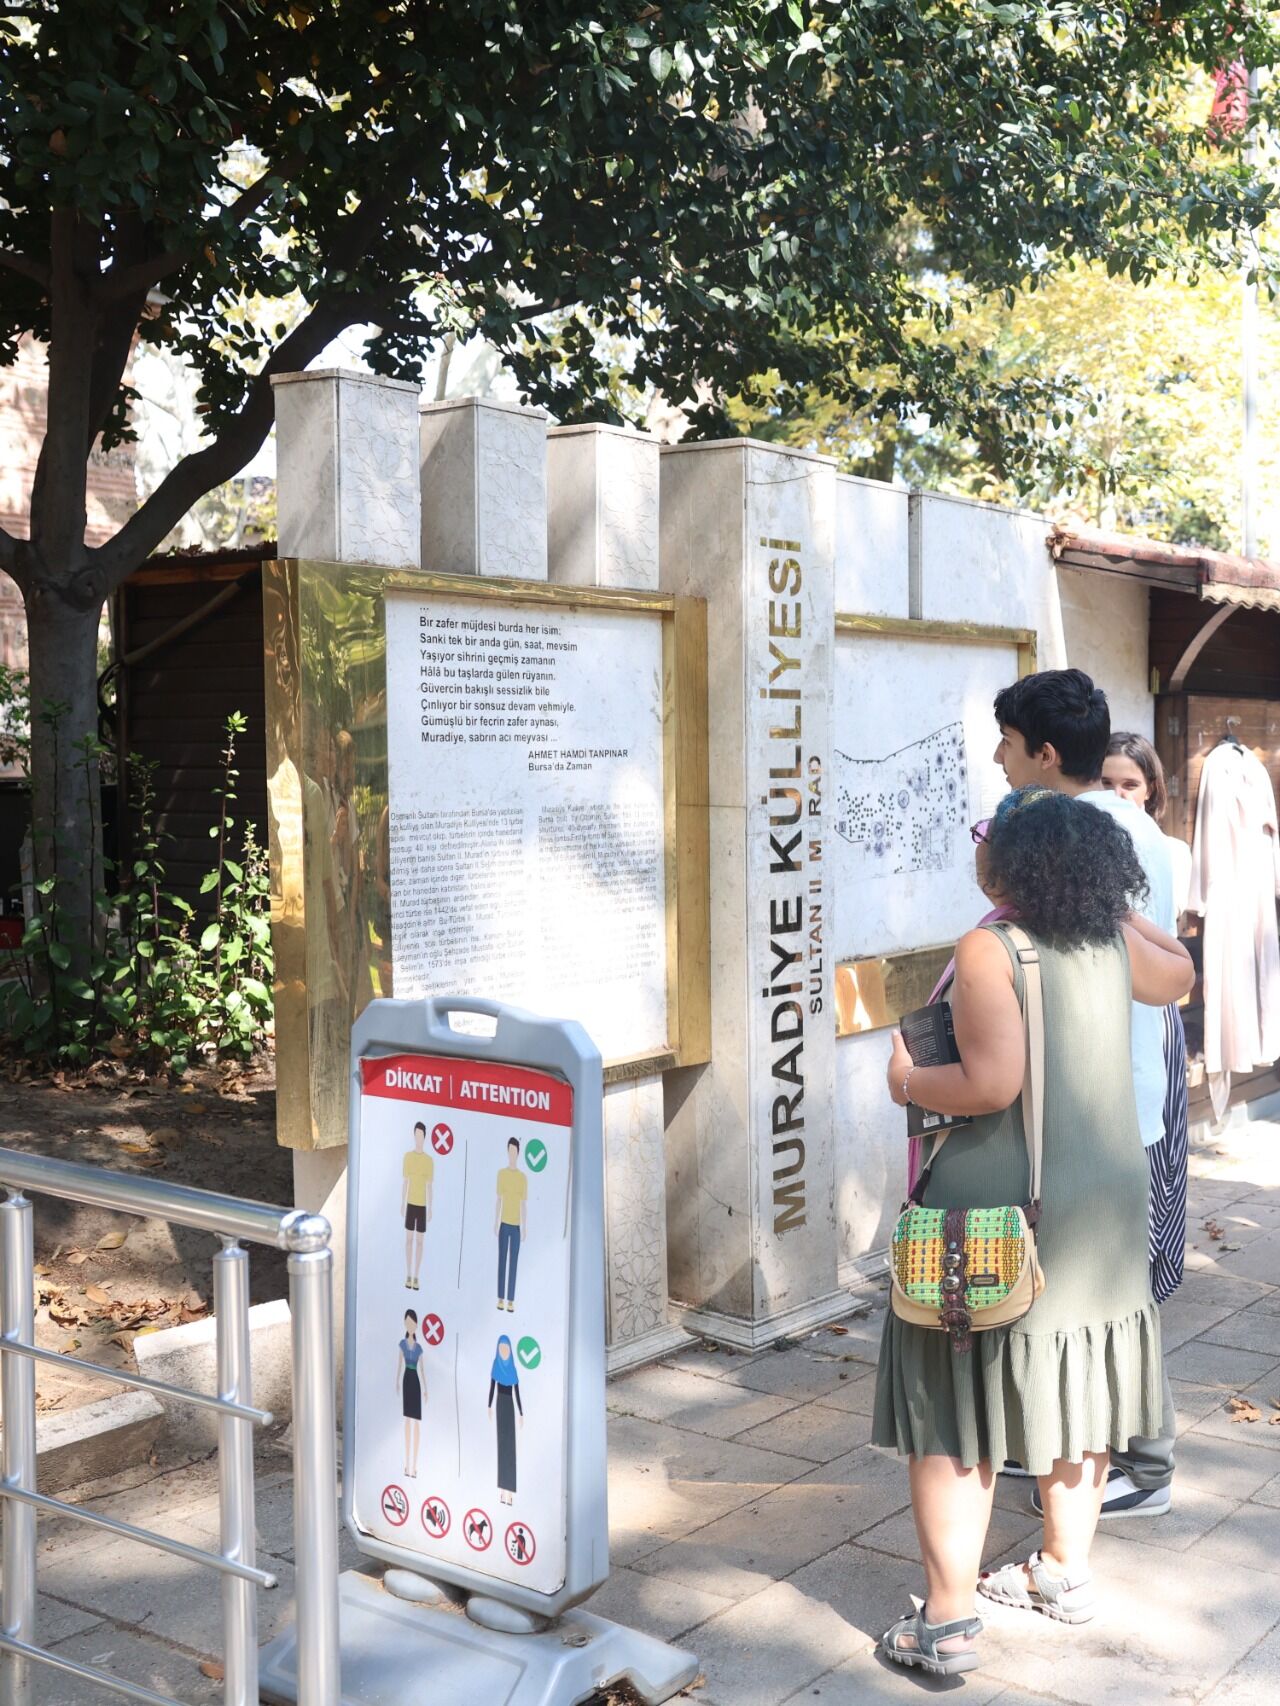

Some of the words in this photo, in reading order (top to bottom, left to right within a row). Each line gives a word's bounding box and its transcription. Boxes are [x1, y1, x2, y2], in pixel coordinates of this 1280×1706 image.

[420, 616, 433, 628] Bir
[436, 618, 458, 629] zafer
[461, 620, 496, 632] müjdesi
[498, 622, 523, 633] burda
[525, 623, 539, 634] her
[420, 632, 446, 644] Sanki
[449, 635, 462, 645] tek
[465, 635, 477, 645] bir
[479, 637, 501, 647] anda
[546, 641, 578, 652] mevsim
[420, 650, 455, 662] Yaşıyor
[457, 652, 485, 662] sihrini
[488, 654, 518, 666] geçmiş
[521, 656, 556, 665] zamanın
[444, 667, 456, 677] bu
[458, 668, 494, 679] taşlarda
[496, 669, 520, 681] gülen
[522, 671, 556, 682] rüyanın.
[420, 682, 462, 694] Güvercin
[465, 684, 494, 696] bakışlı
[496, 686, 533, 696] sessizlik
[535, 686, 550, 696] bile
[460, 700, 471, 710] bir
[474, 702, 505, 711] sonsuz
[508, 701, 535, 711] devam
[538, 702, 576, 714] vehmiyle.
[759, 537, 804, 872] KÜLLİYESİ
[421, 715, 463, 728] Gümüşlü
[465, 716, 477, 726] bir
[480, 716, 504, 726] fecrin
[507, 717, 527, 727] zafer
[421, 732, 467, 744] Muradiye,
[468, 732, 497, 742] sabrın
[499, 734, 511, 742] acı
[514, 734, 548, 745] meyvası
[528, 750, 558, 759] AHMET
[560, 749, 587, 758] HAMDİ
[589, 749, 628, 758] TANPINAR
[528, 762, 564, 771] Bursa'da
[566, 762, 592, 771] Zaman
[808, 755, 822, 862] MRAD
[809, 905, 823, 1015] SULTAN
[762, 896, 806, 1233] MURADİYE
[385, 1067, 443, 1094] DİKKAT
[460, 1081, 550, 1110] ATTENTION
